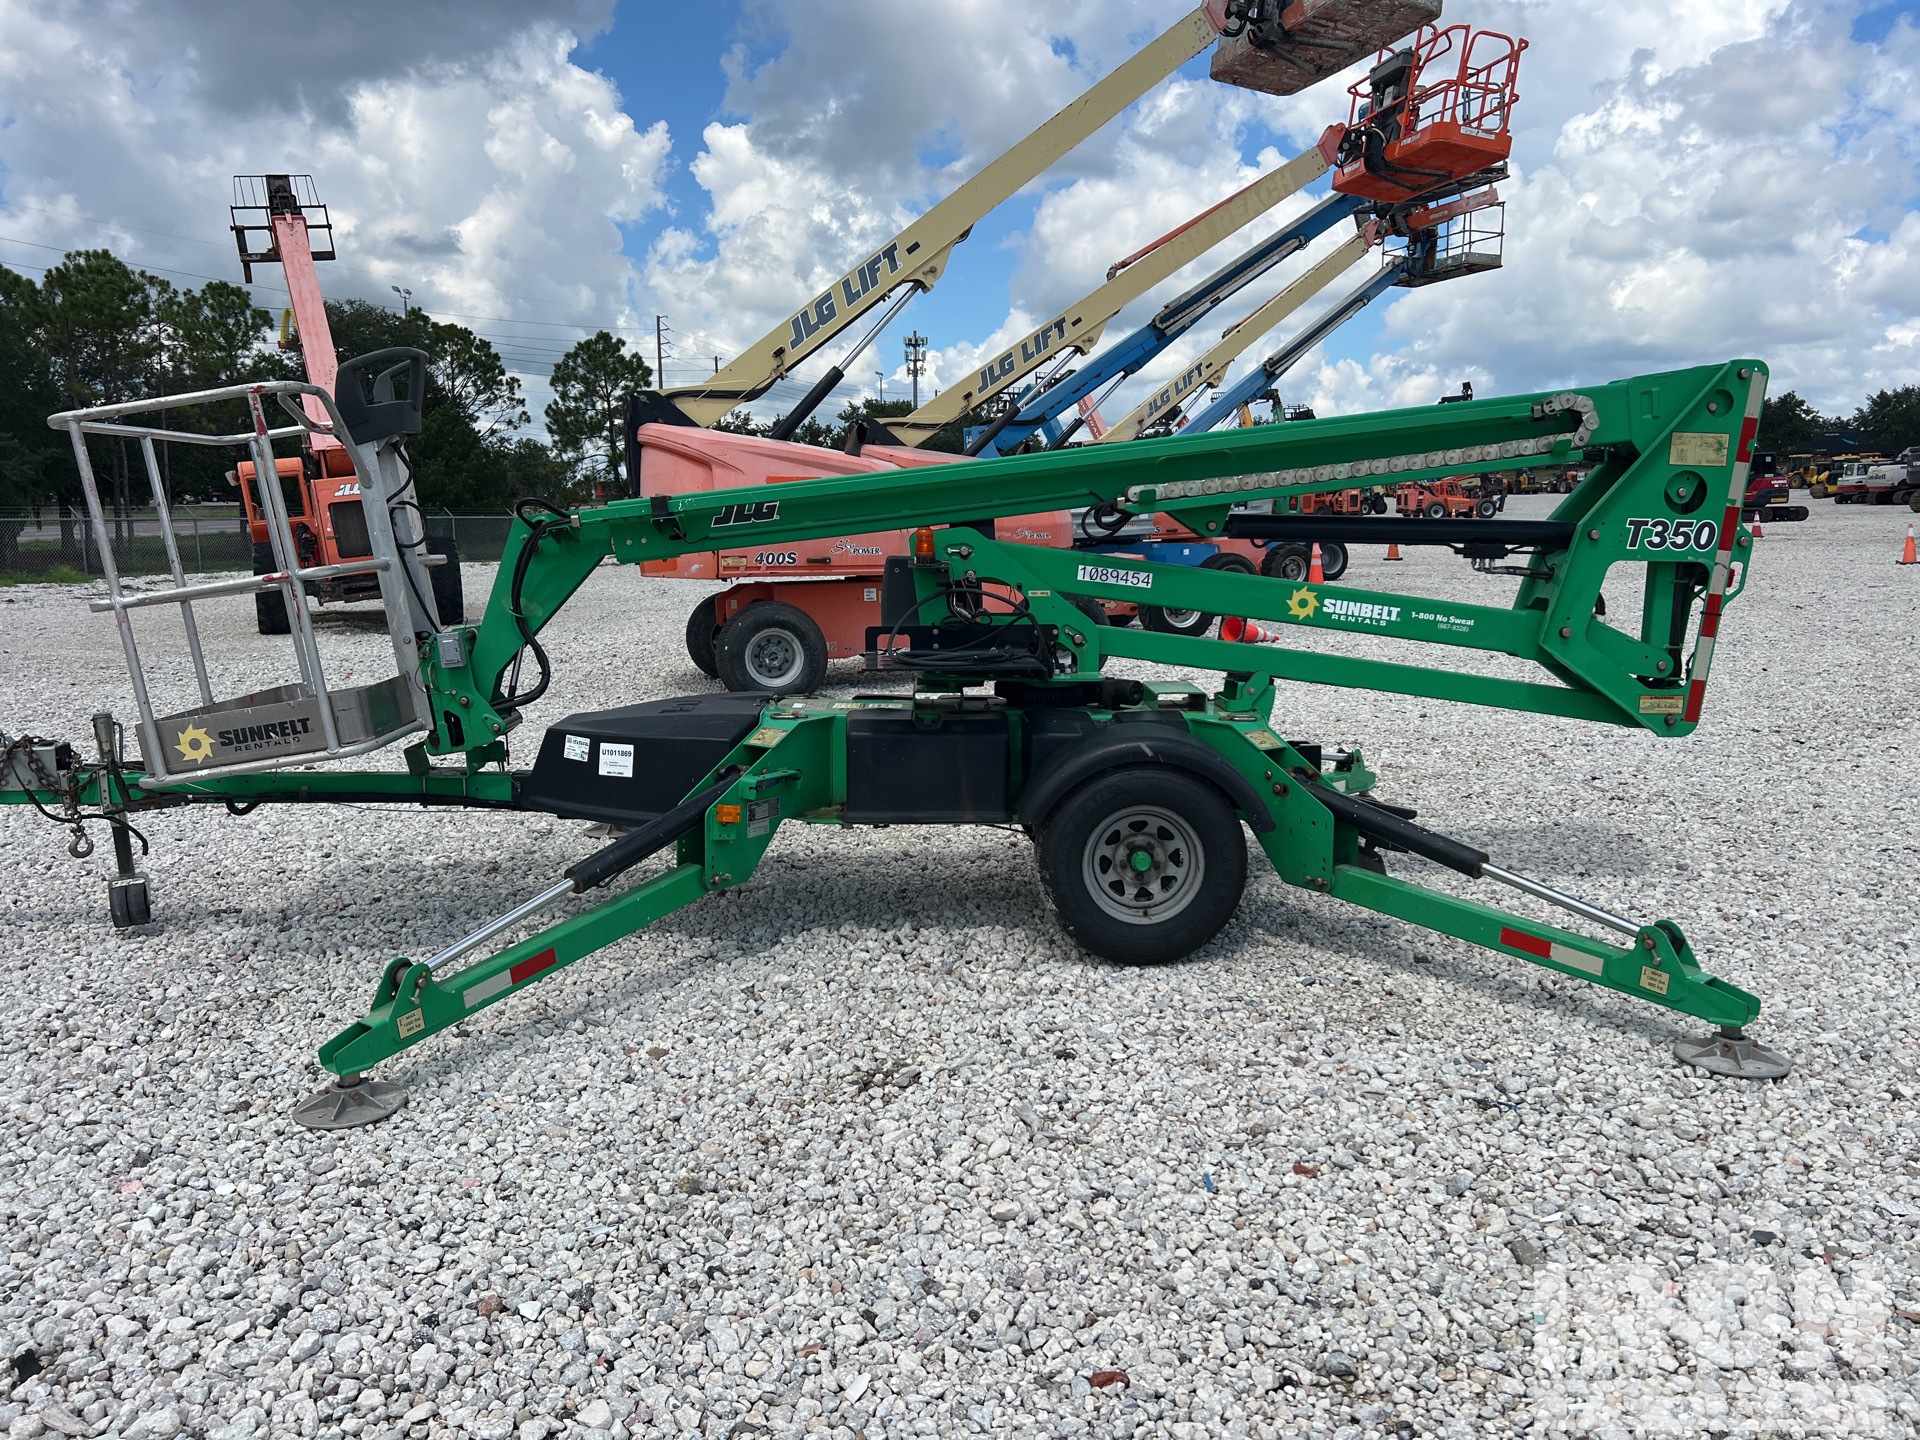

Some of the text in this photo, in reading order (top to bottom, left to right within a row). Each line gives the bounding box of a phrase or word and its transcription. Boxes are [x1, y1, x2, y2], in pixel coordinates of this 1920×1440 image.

[788, 240, 899, 352] JLG LIFT
[977, 315, 1066, 396] JLG LIFT
[1146, 361, 1203, 418] JLG LIFT
[711, 501, 779, 527] JLG
[1626, 518, 1717, 551] T350
[755, 551, 797, 566] 400S
[852, 547, 881, 555] POWER
[1079, 566, 1151, 587] 1089454
[1323, 599, 1400, 621] SUNBELT
[1331, 614, 1387, 627] RENTALS
[1411, 611, 1474, 626] 1-800 No Sweat
[218, 718, 310, 747] SUNBELT
[234, 737, 301, 752] RENTALS
